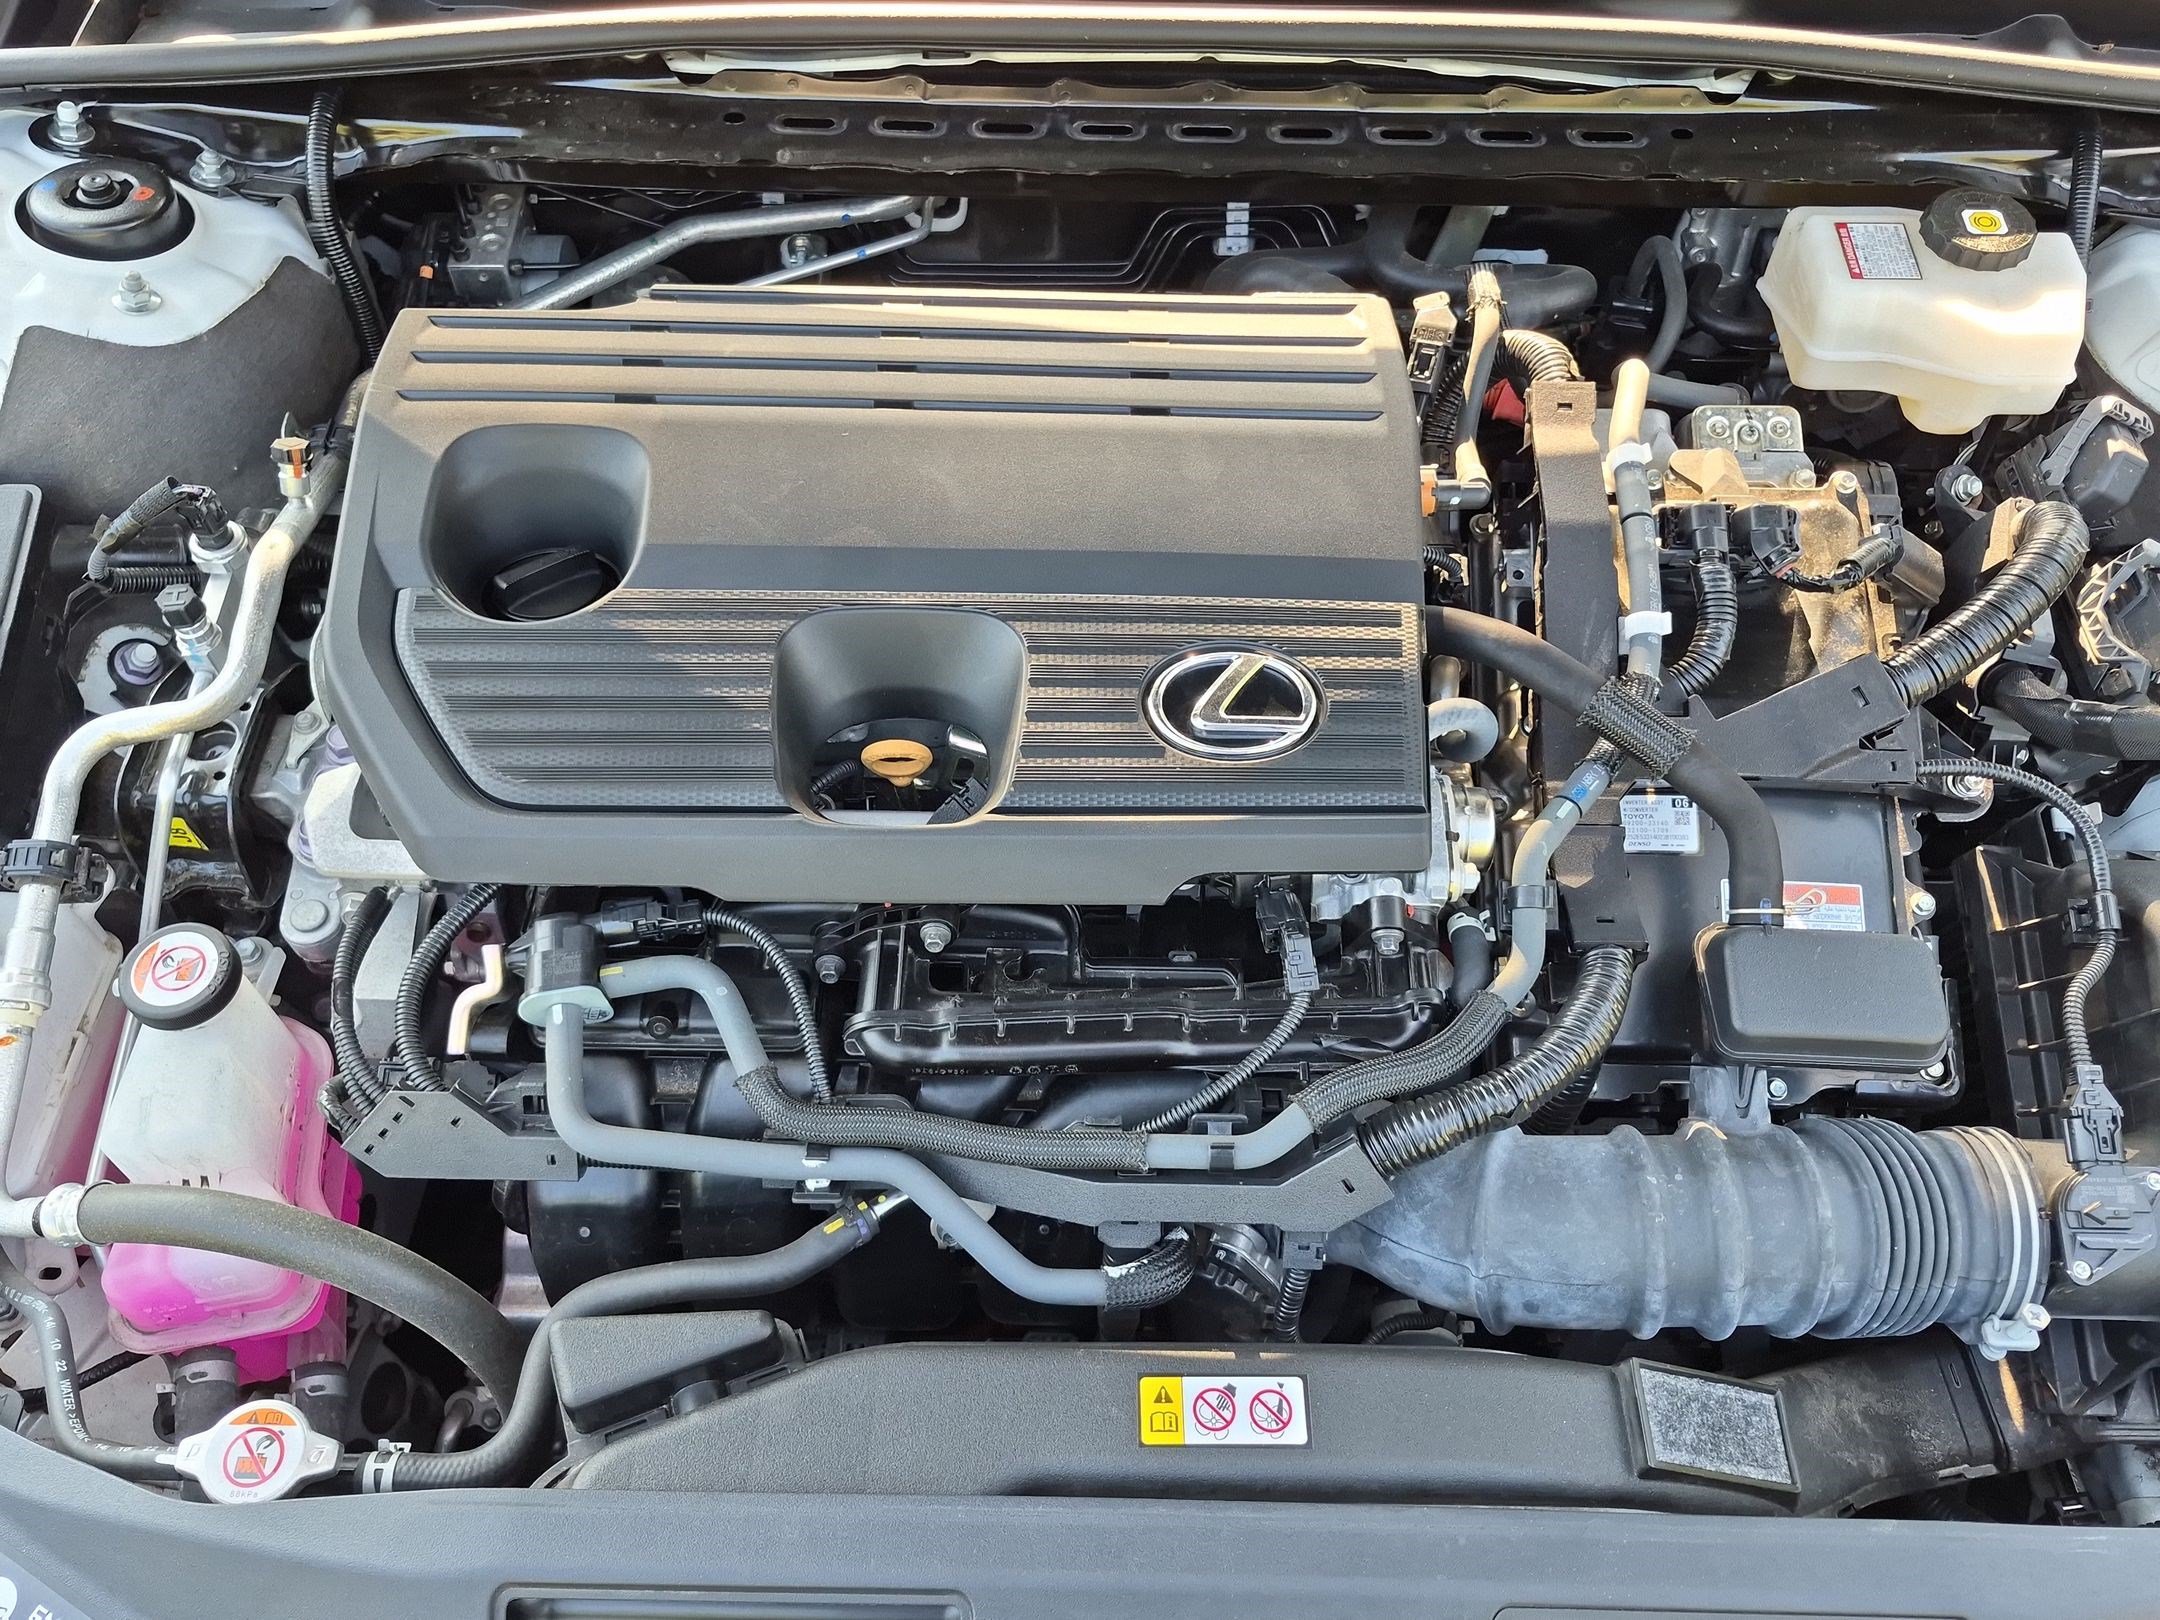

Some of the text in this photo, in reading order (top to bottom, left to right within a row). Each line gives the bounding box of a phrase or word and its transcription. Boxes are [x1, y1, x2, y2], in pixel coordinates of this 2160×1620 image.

[1674, 799, 1689, 808] 06
[50, 1338, 62, 1350] 10
[55, 1360, 68, 1373] 22
[60, 1379, 76, 1412] WATER
